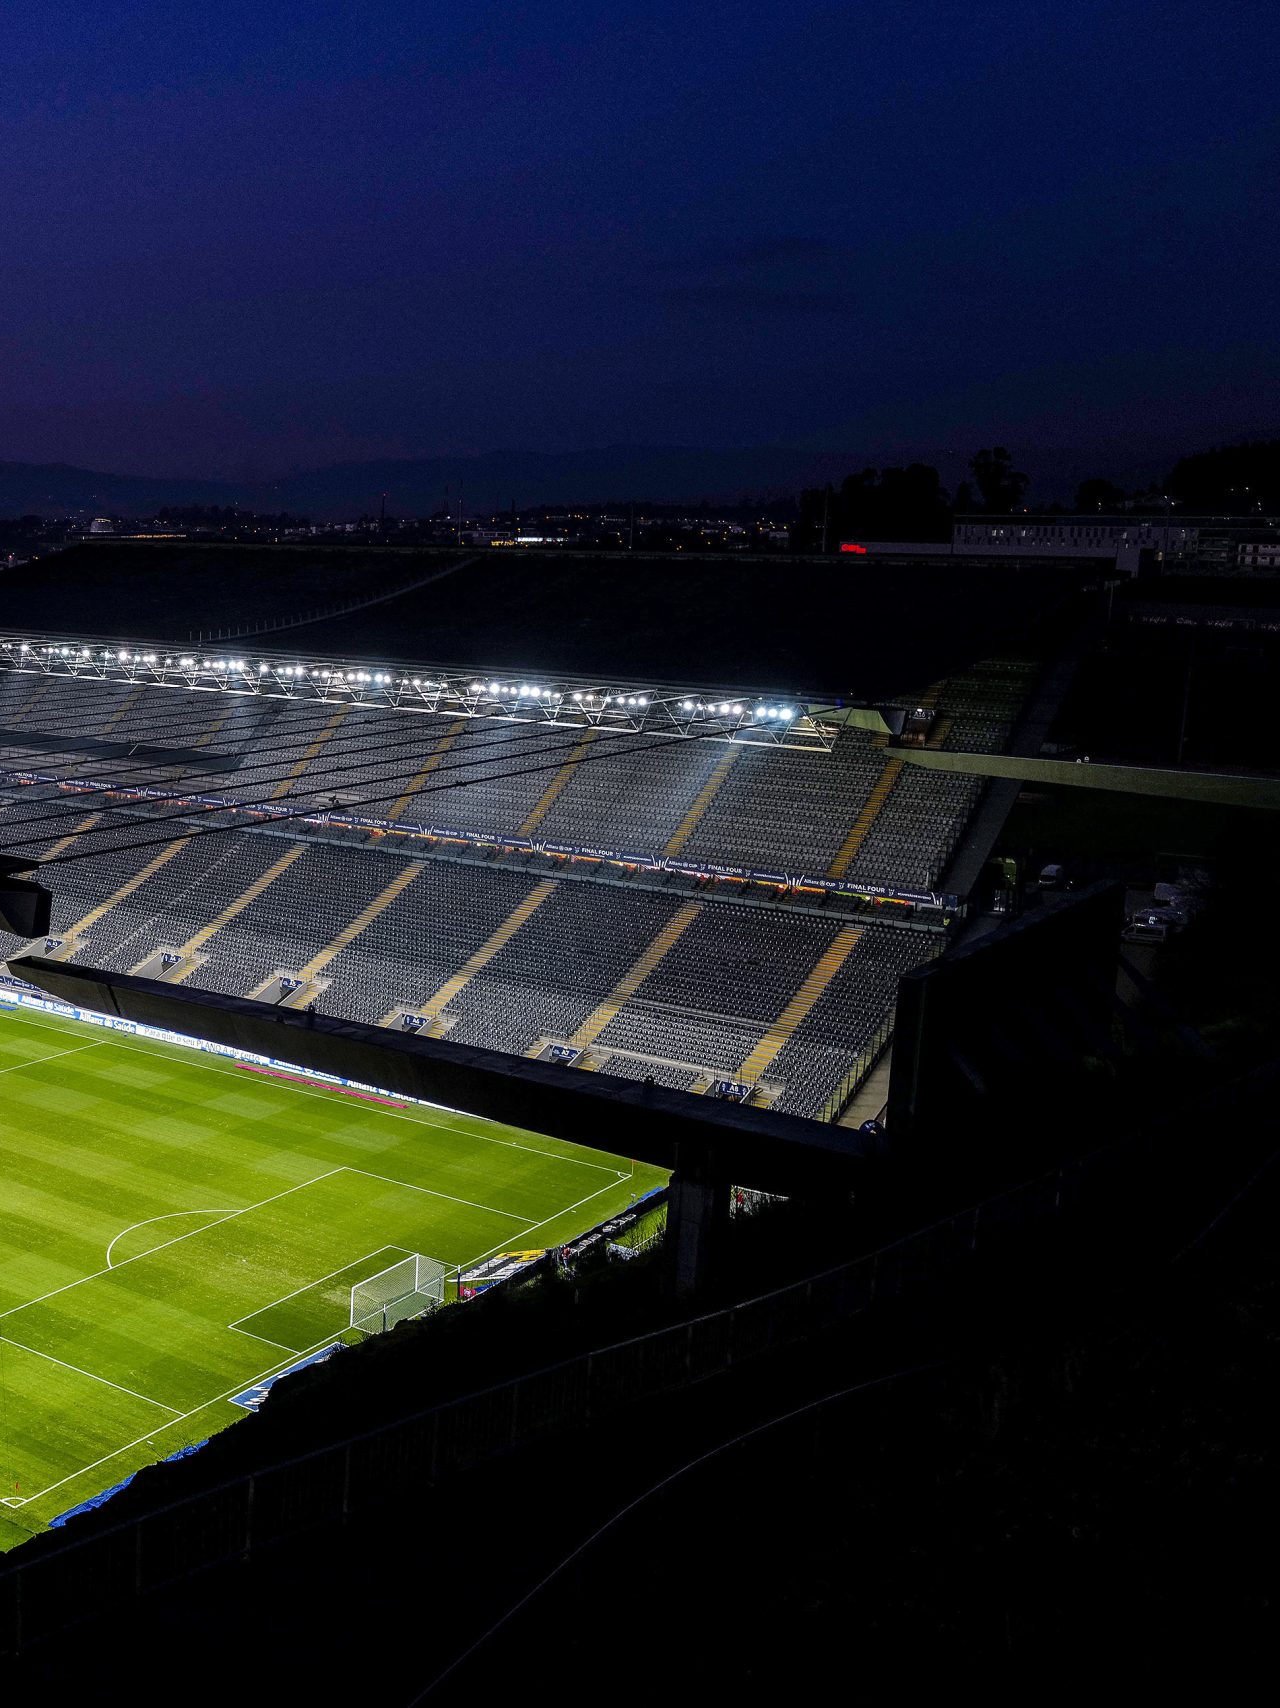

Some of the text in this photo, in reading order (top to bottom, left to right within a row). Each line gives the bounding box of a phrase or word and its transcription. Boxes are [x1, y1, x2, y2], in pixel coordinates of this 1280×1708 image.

[707, 864, 726, 872] FINAL
[847, 883, 867, 891] FINAL
[867, 885, 886, 893] FOUR
[21, 994, 45, 1008] Allianz
[81, 1011, 106, 1026] Allianz
[144, 1027, 161, 1037] Para
[162, 1032, 176, 1043] que
[182, 1037, 196, 1046] seu
[196, 1039, 222, 1053] PLANO
